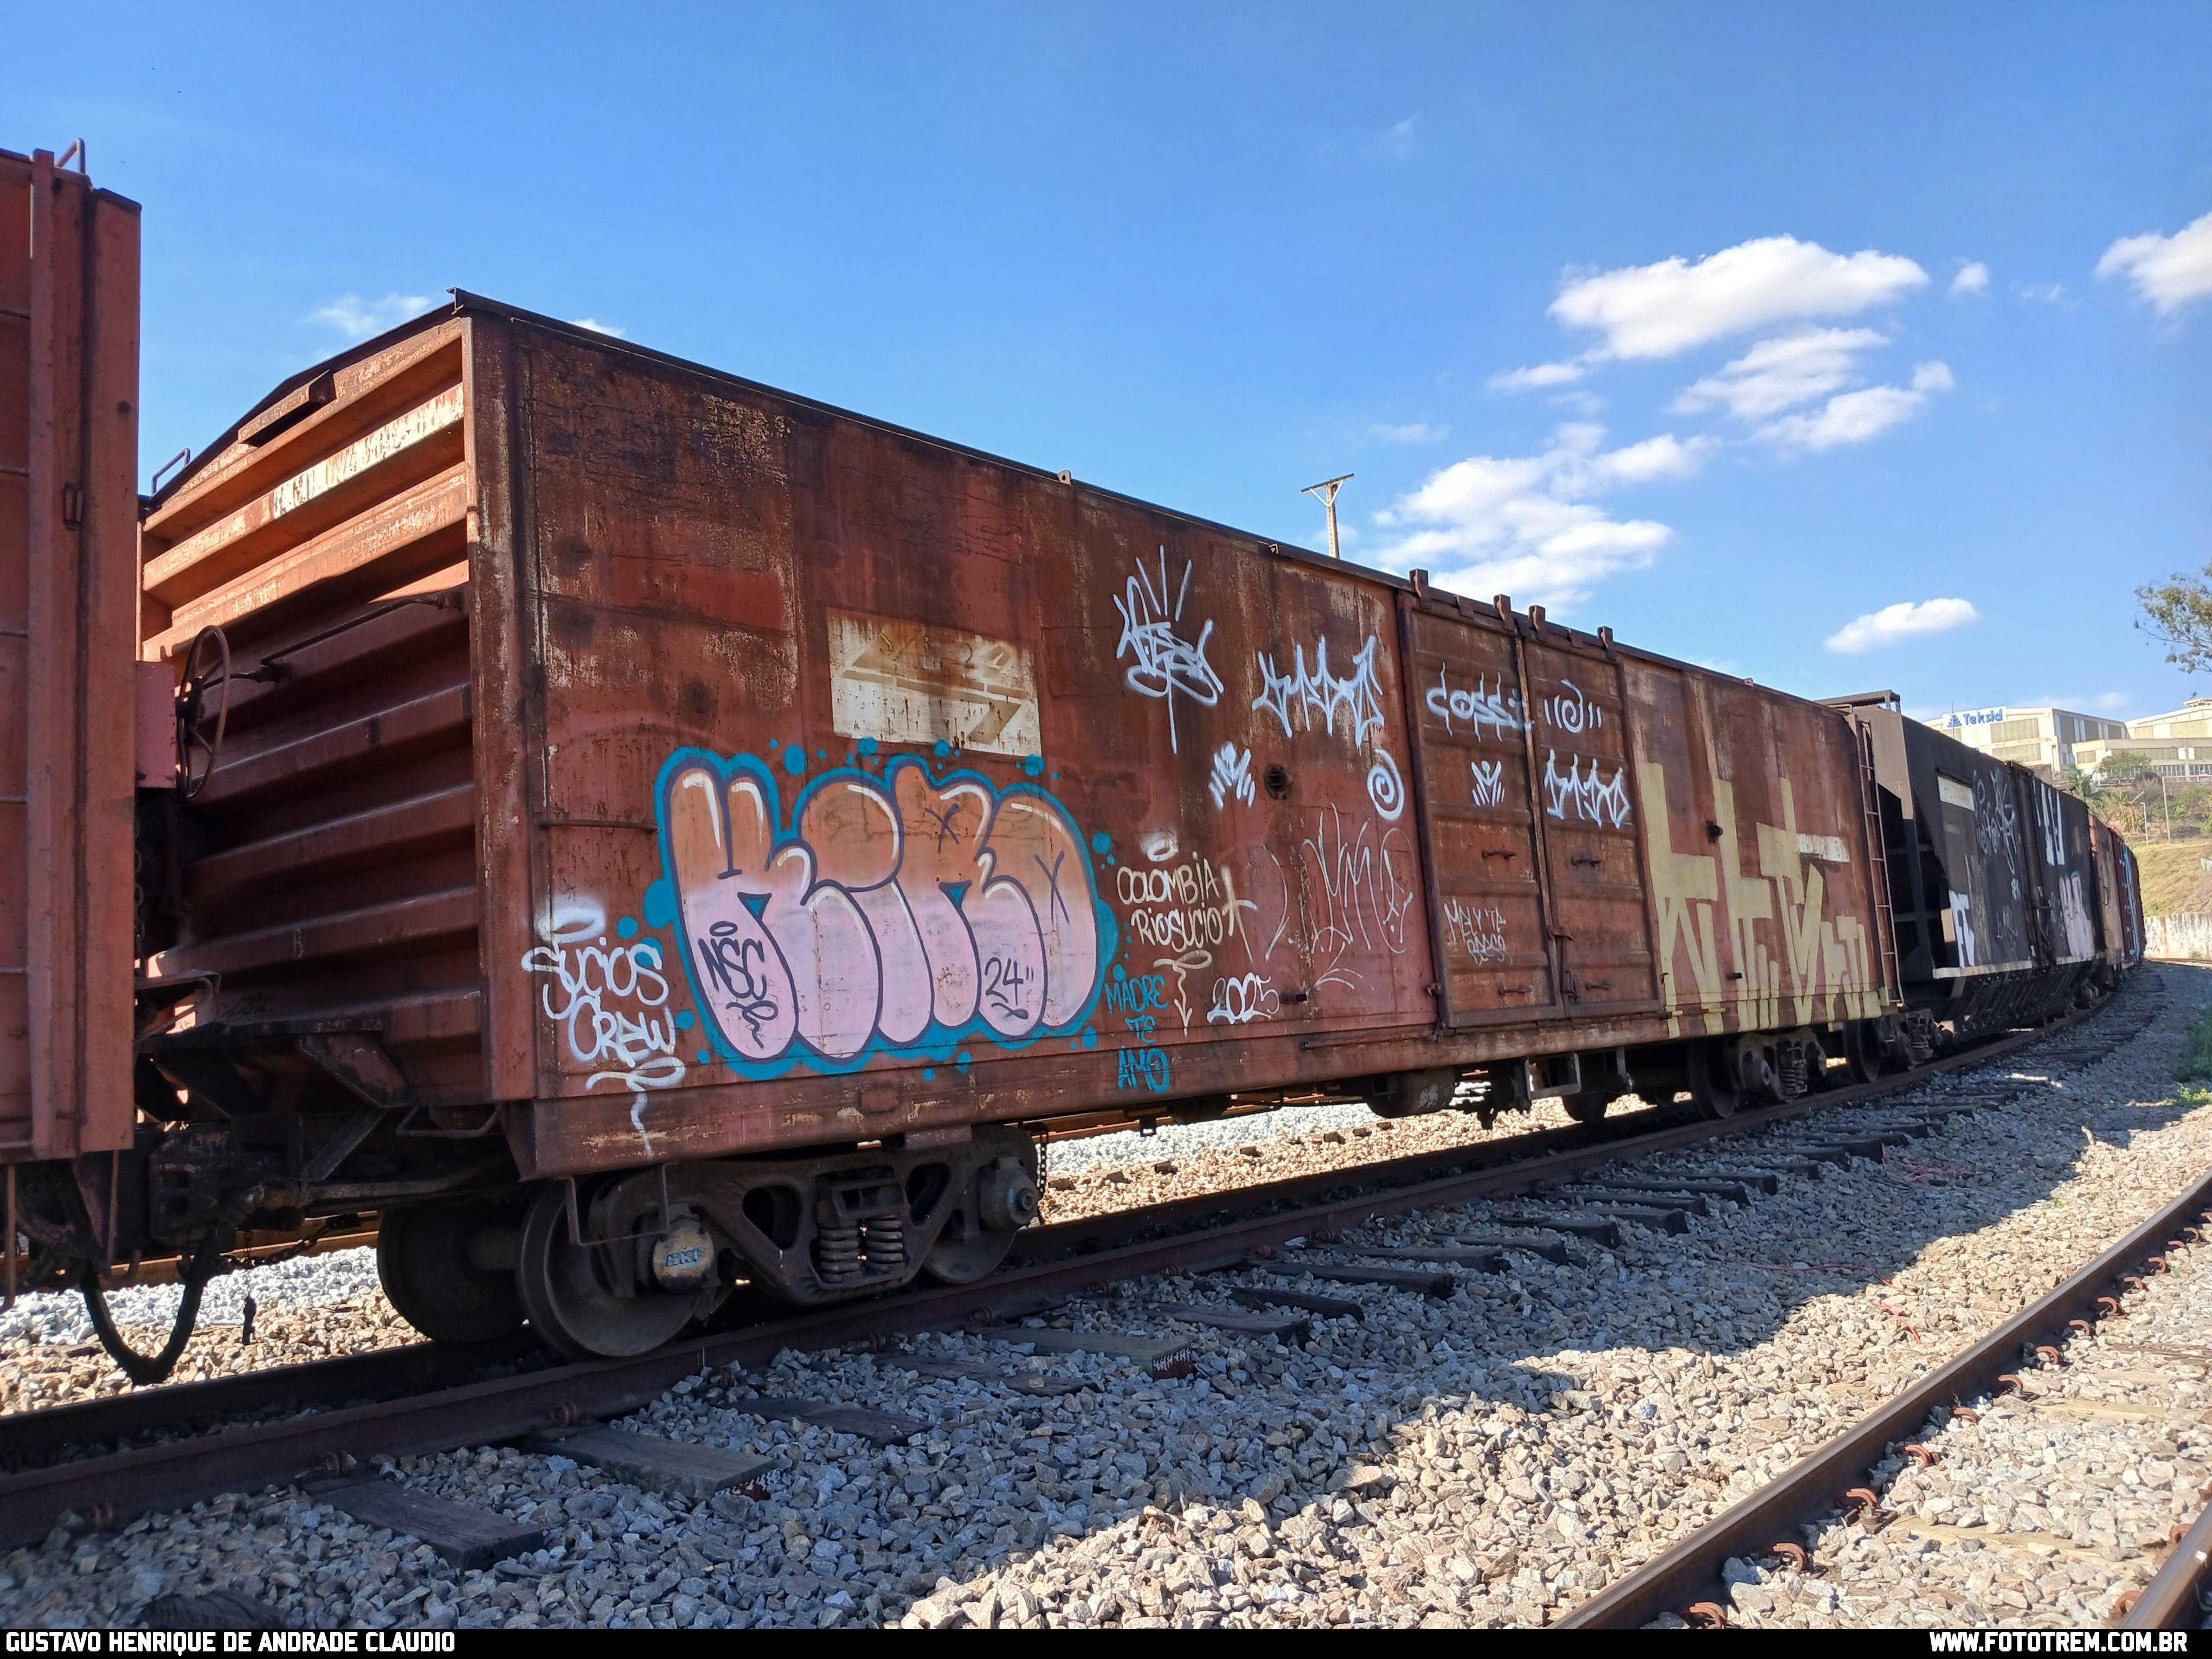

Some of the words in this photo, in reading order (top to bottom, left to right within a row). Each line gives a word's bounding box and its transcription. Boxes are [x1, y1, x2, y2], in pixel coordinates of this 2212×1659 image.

[1963, 709, 2003, 725] Teksid
[1104, 974, 1169, 1014] MADRE
[1207, 972, 1279, 1024] 2025
[1124, 1015, 1156, 1045] TE
[1117, 1046, 1171, 1094] AMO
[666, 1247, 705, 1267] SKF
